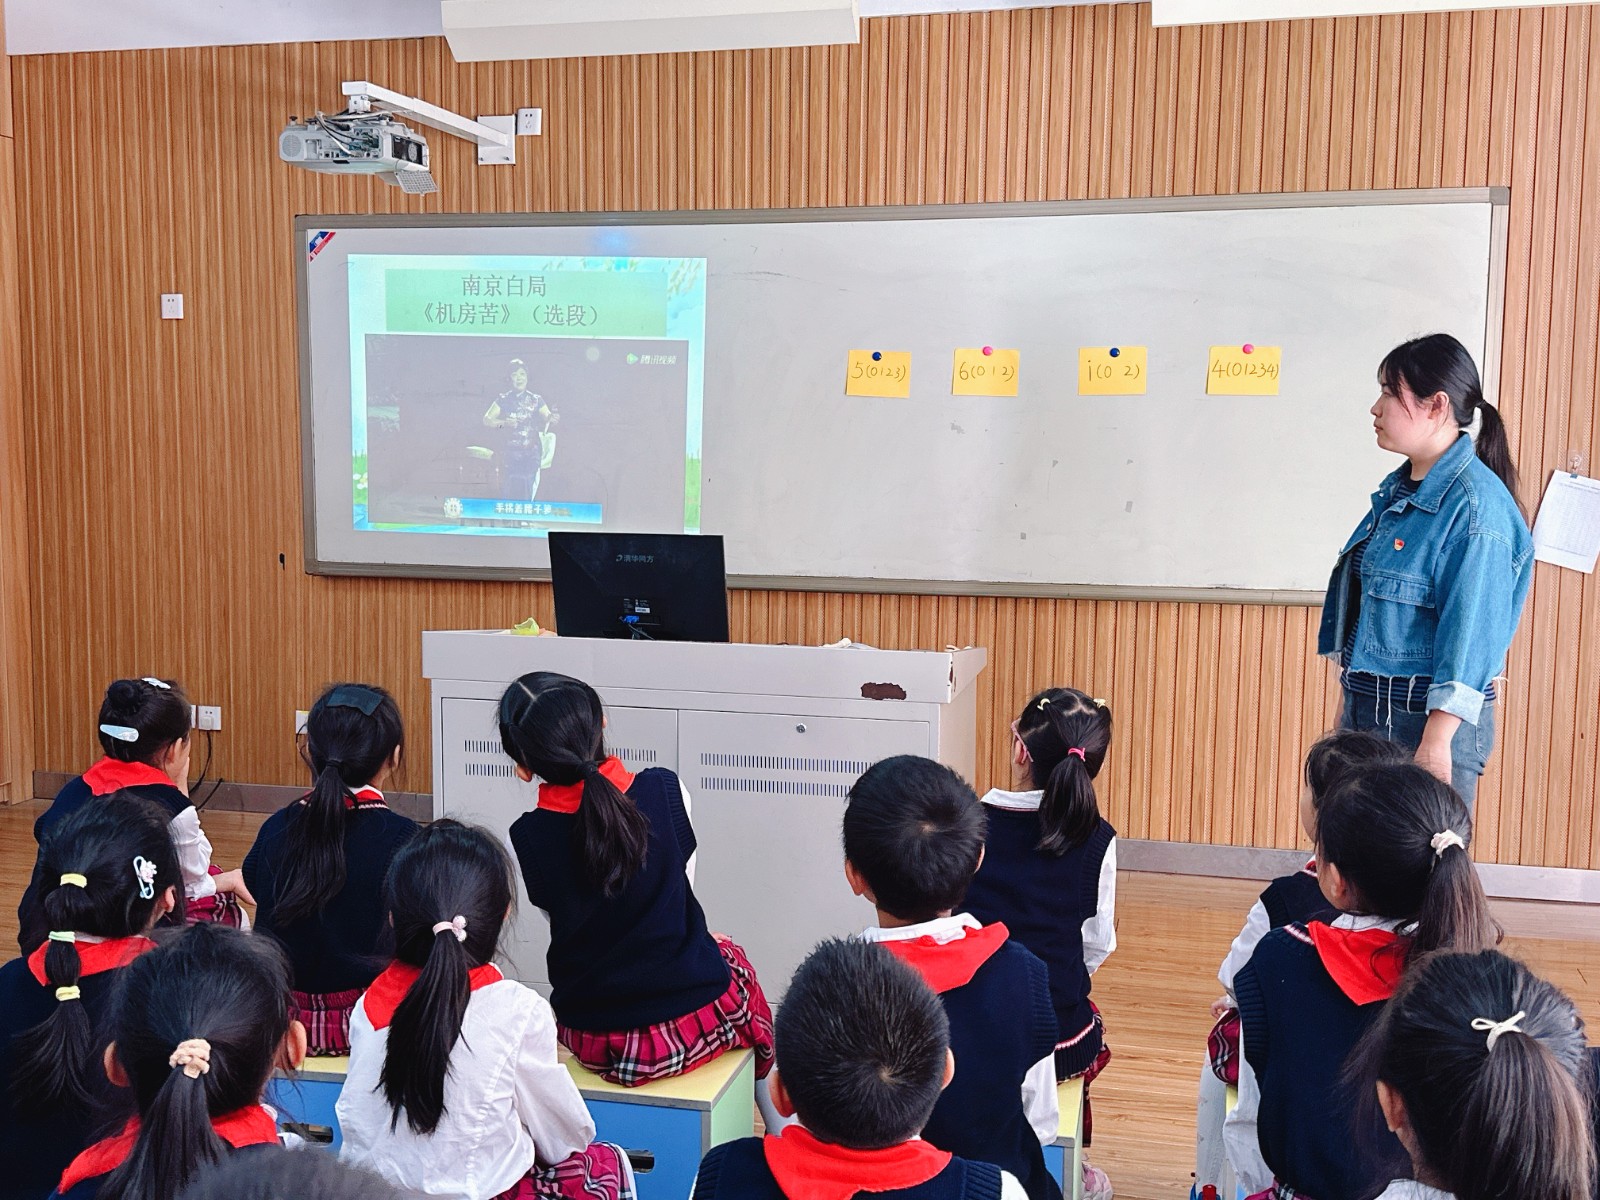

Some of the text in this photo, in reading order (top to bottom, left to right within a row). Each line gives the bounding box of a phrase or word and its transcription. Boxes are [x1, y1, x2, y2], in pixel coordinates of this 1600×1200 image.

[461, 273, 547, 298] 南京白局
[640, 354, 677, 365] 腾讯视频
[1211, 359, 1279, 380] 4(01234)
[623, 554, 655, 563] 清华同方
